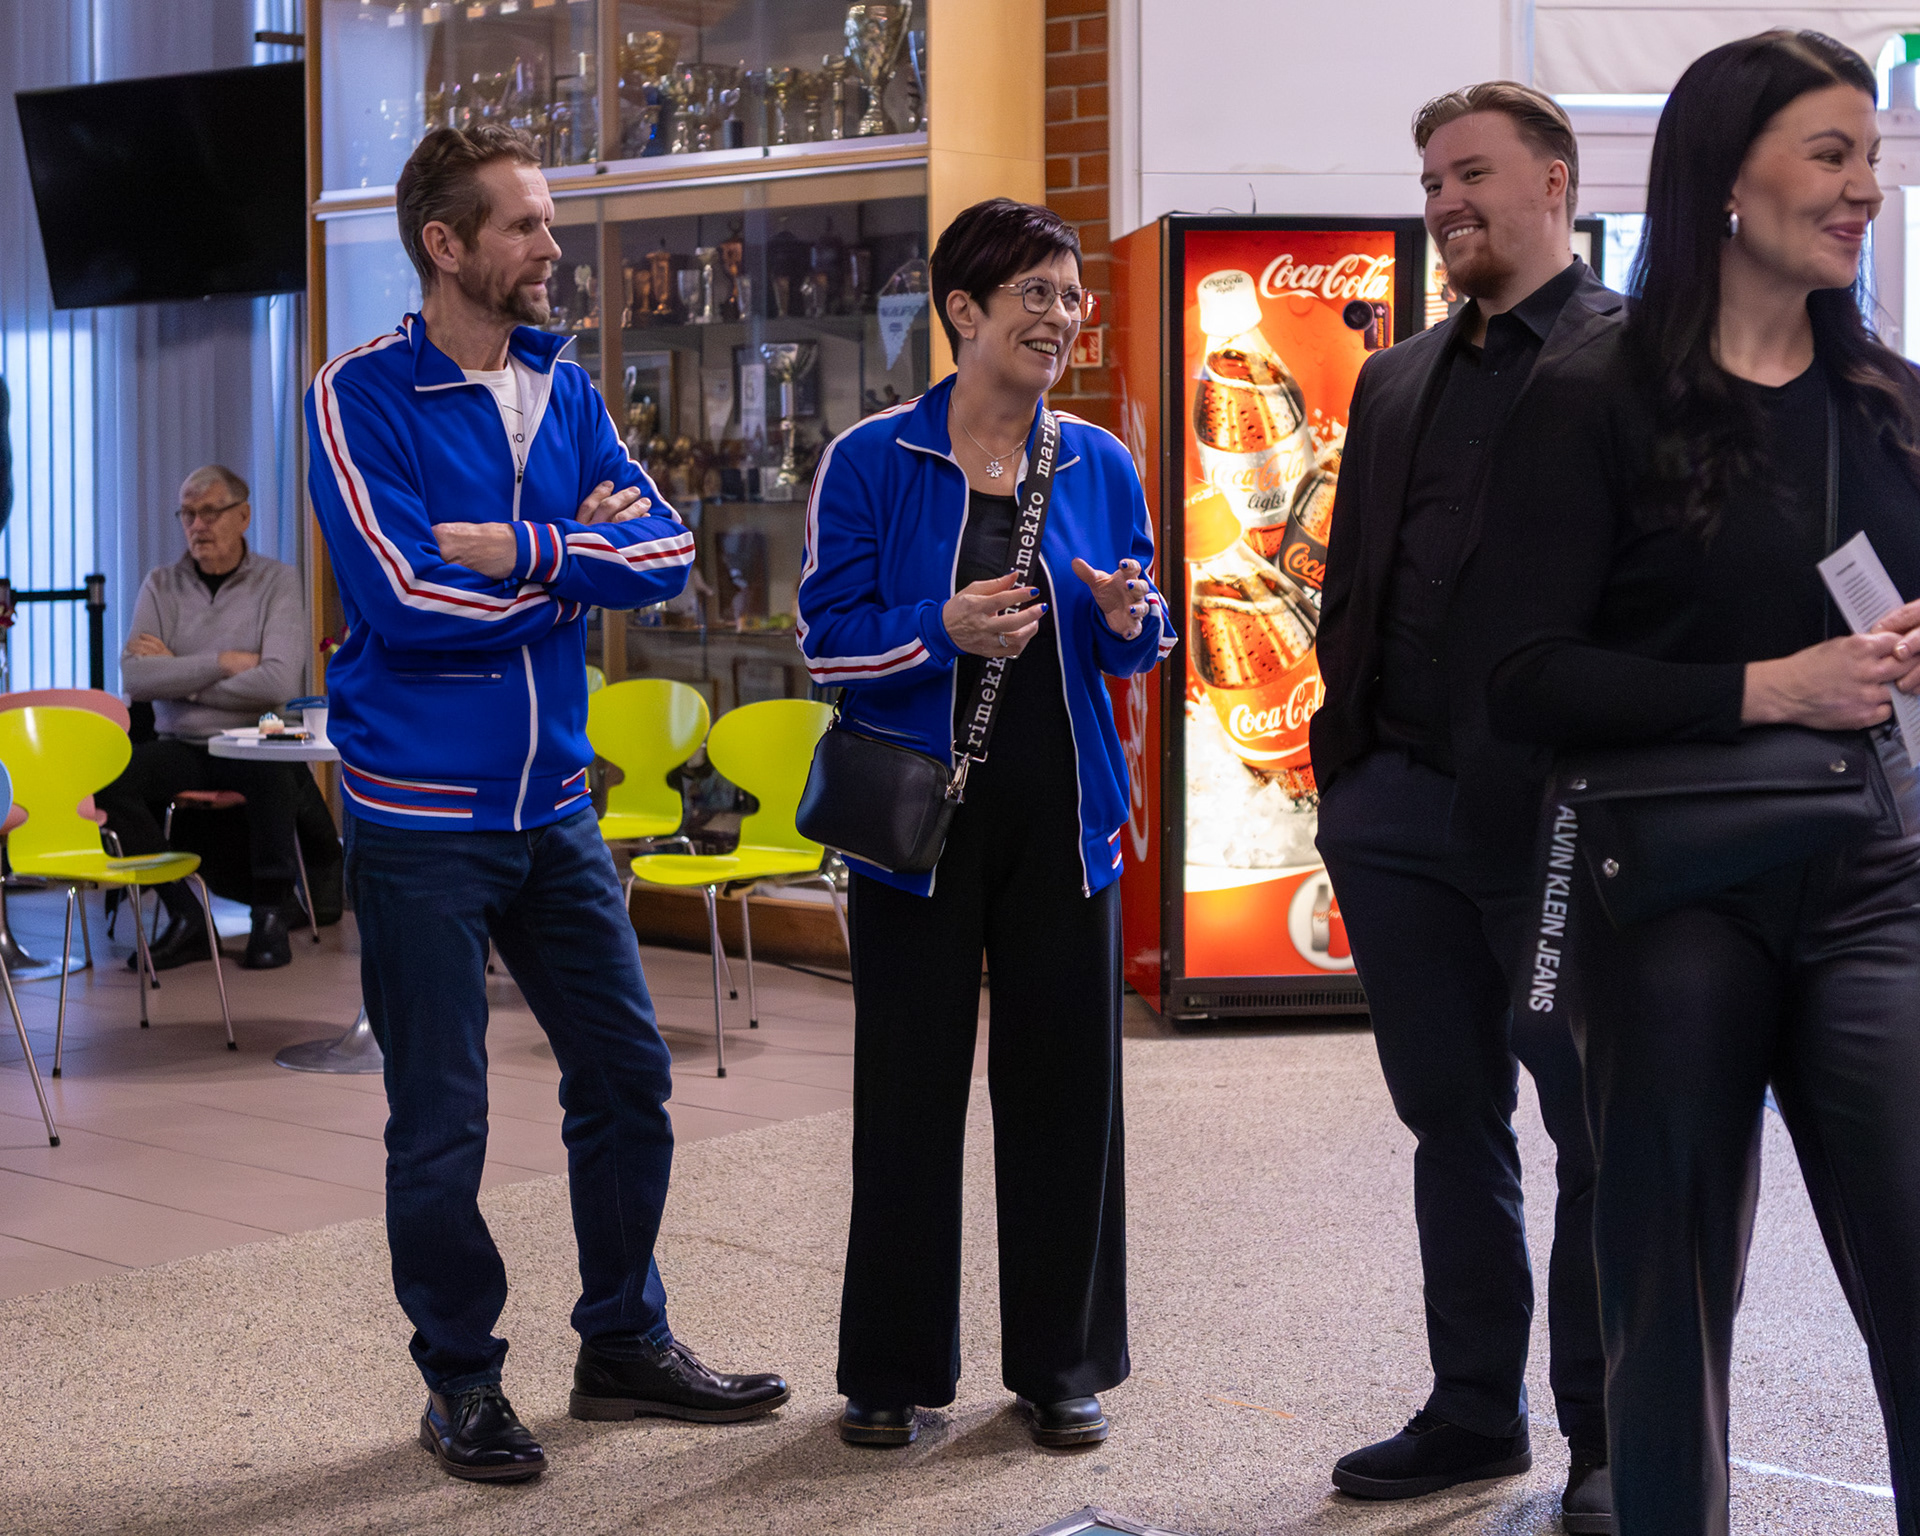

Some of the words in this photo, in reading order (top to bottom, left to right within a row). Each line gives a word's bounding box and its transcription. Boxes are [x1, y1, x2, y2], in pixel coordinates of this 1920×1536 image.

[1259, 254, 1396, 299] Coca-Cola
[1248, 490, 1288, 515] light
[1548, 805, 1578, 870] ALVIN
[1539, 872, 1571, 937] KLEIN
[1529, 939, 1561, 1013] JEANS
